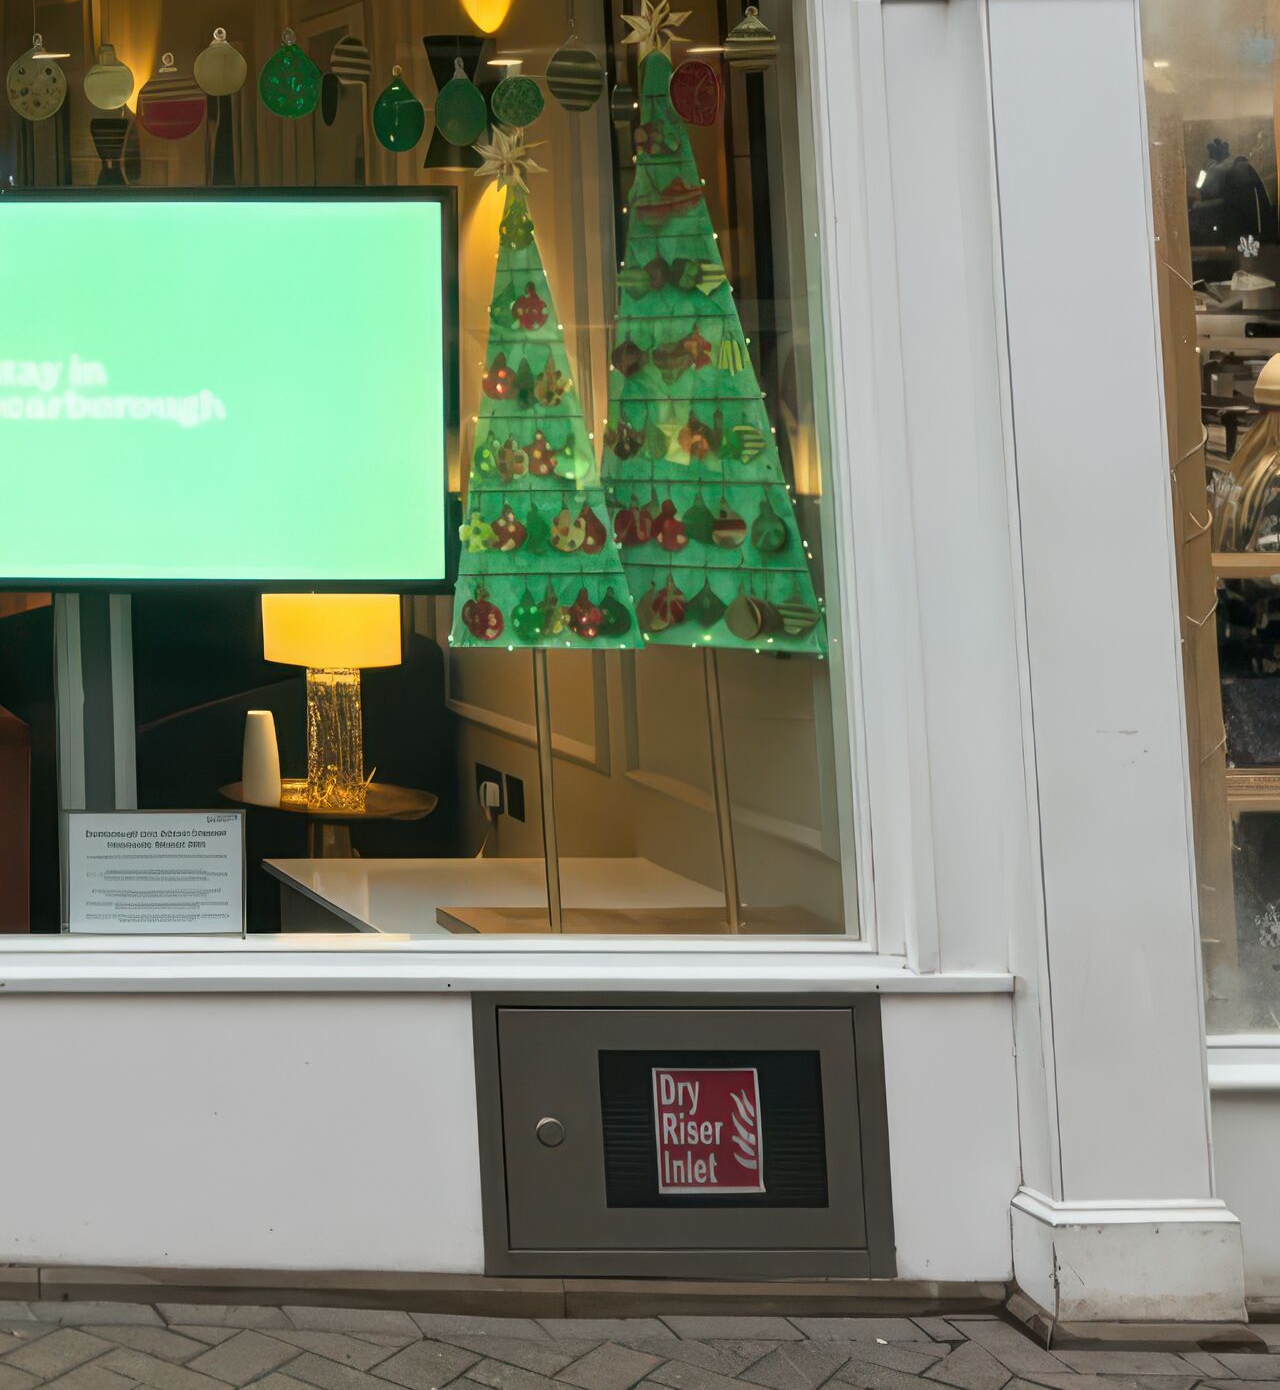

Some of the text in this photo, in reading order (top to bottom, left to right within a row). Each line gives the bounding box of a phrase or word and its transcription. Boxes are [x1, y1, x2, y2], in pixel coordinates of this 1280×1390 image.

[659, 1073, 700, 1115] Dry
[662, 1112, 724, 1146] Riser
[663, 1150, 718, 1184] Inlet
